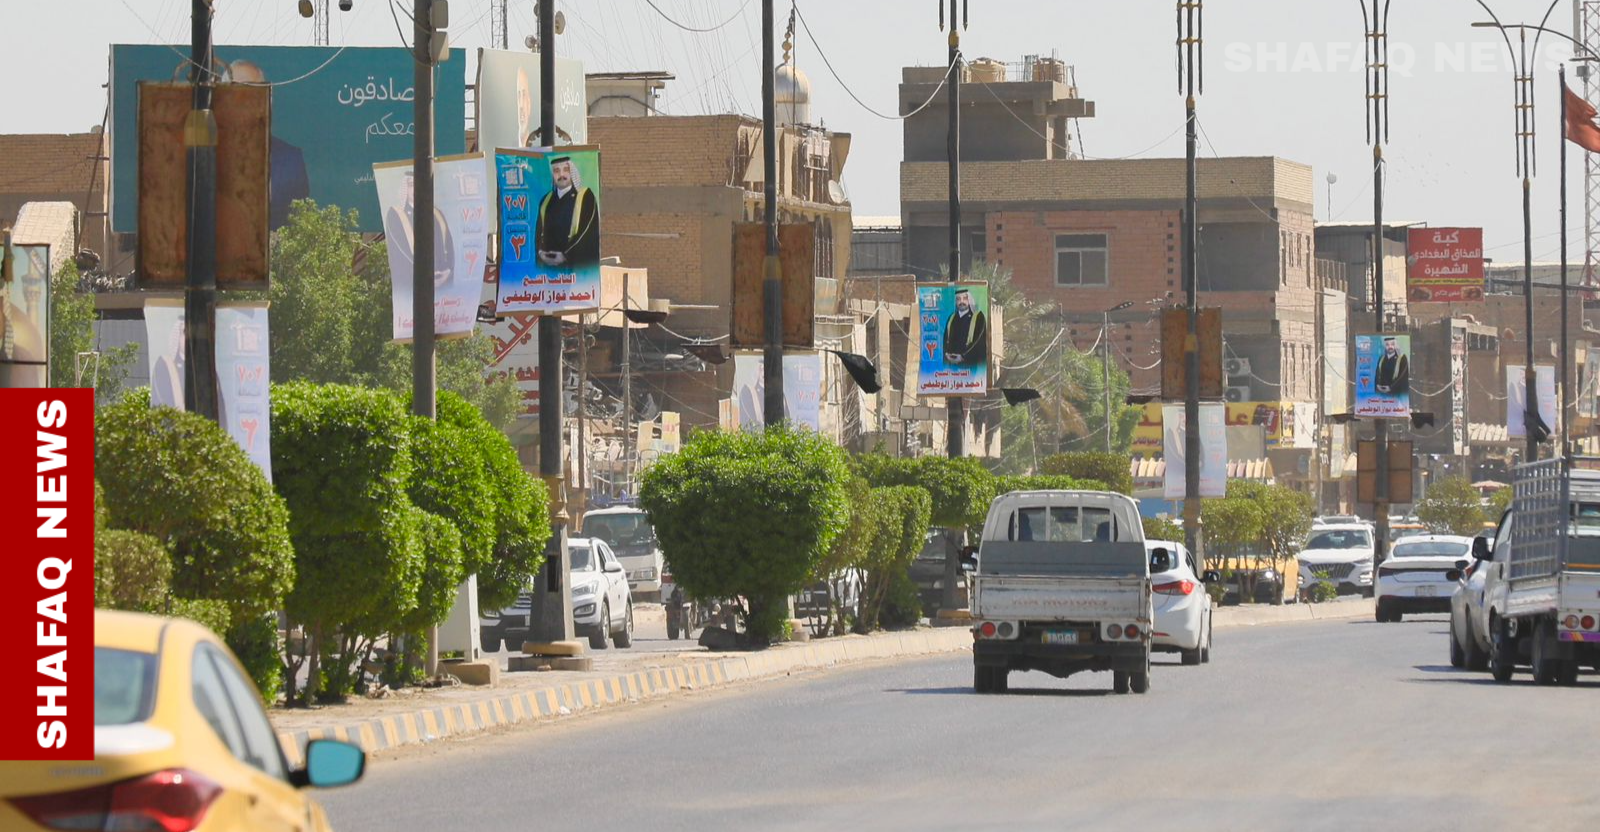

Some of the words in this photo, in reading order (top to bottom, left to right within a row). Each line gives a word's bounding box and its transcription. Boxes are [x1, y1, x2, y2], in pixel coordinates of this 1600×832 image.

[338, 76, 415, 107] صادقون
[504, 194, 526, 212] ٢٠٧
[1433, 230, 1459, 246] كبة
[509, 234, 526, 260] ٣
[1451, 248, 1481, 261] المذاق
[1424, 262, 1468, 277] الشهيرة
[546, 289, 568, 304] فواز
[569, 286, 595, 302] أحمد
